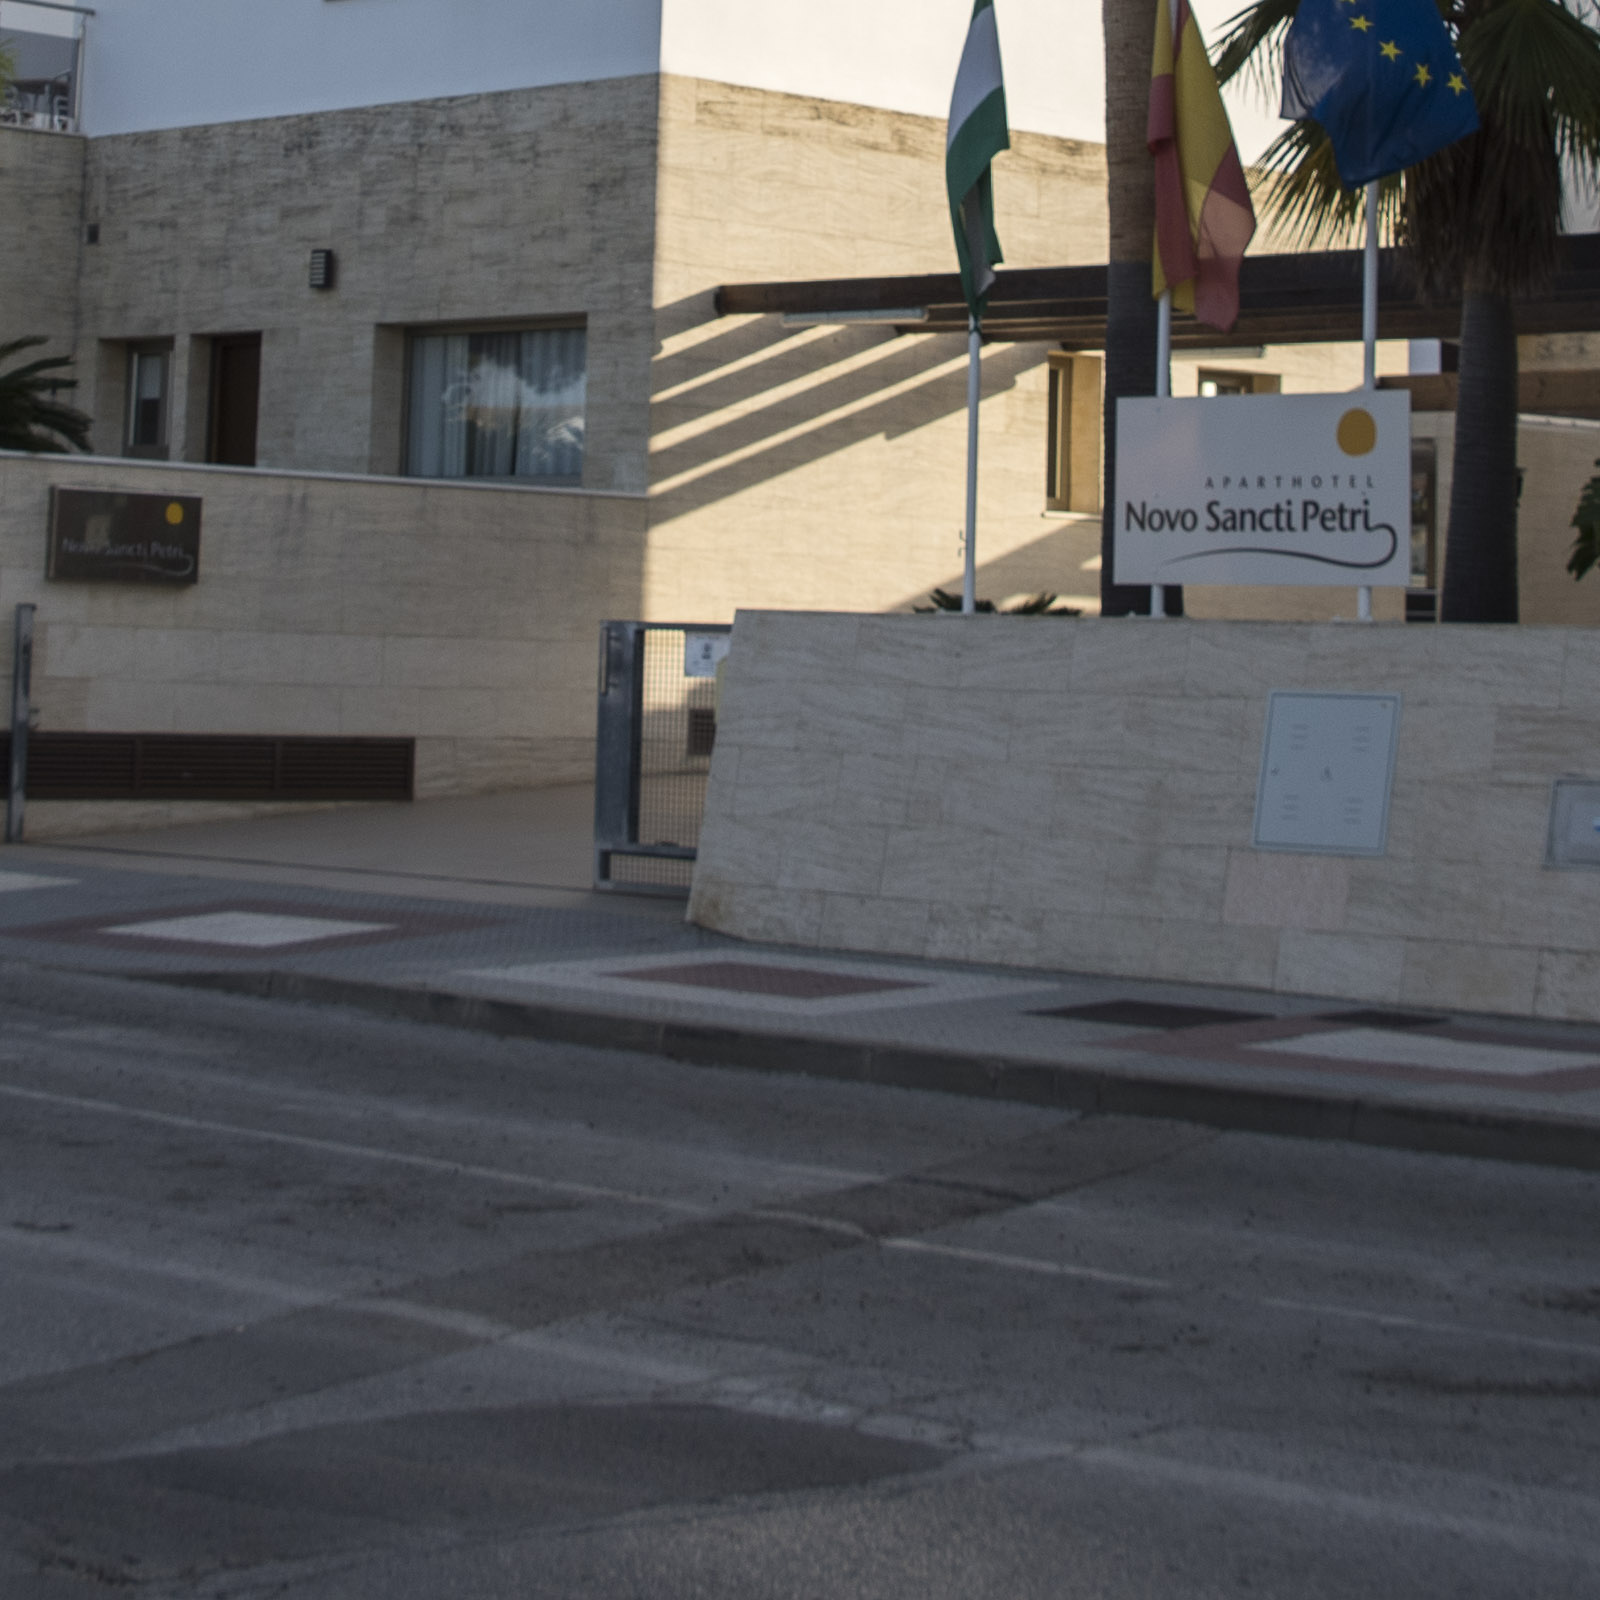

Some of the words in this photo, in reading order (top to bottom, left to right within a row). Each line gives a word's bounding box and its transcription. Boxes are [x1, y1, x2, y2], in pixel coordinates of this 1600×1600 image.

[1204, 474, 1374, 490] APARTHOTEL
[1125, 500, 1198, 533] Novo
[1204, 499, 1296, 533] Sancti
[1300, 499, 1373, 533] Petri
